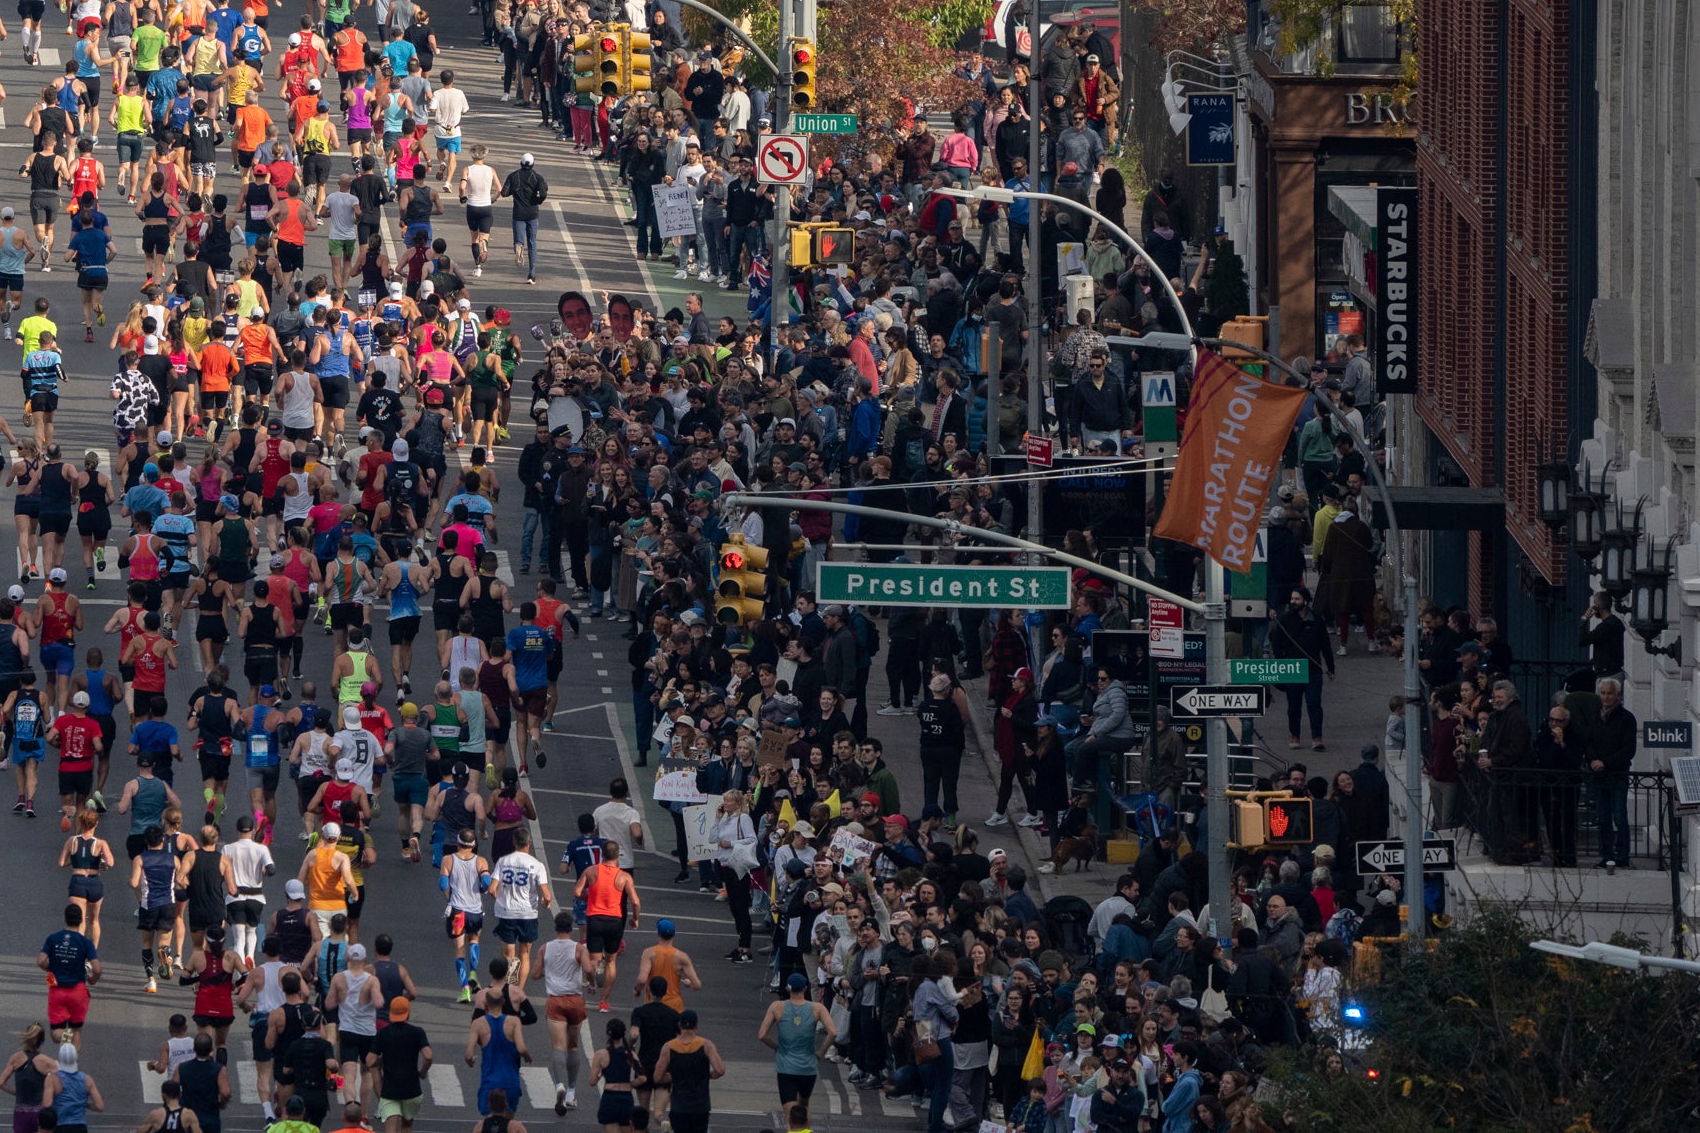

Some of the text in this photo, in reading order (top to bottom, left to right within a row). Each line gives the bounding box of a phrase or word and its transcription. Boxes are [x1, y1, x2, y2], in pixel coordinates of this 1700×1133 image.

[1192, 97, 1227, 107] RANA
[798, 115, 852, 132] Union St
[1331, 293, 1347, 301] Open
[1386, 202, 1408, 381] STARBUCKS
[1196, 375, 1261, 553] MARATHON
[1058, 478, 1127, 489] CALL NOW
[1221, 459, 1272, 568] ROUTE
[847, 572, 1041, 598] President St
[1151, 608, 1169, 617] Anytime
[1236, 661, 1301, 675] President
[1258, 674, 1280, 682] Street
[1189, 695, 1252, 707] ONE WAY
[1647, 727, 1684, 743] blink
[1373, 848, 1443, 864] ONE AY
[502, 868, 529, 887] 33
